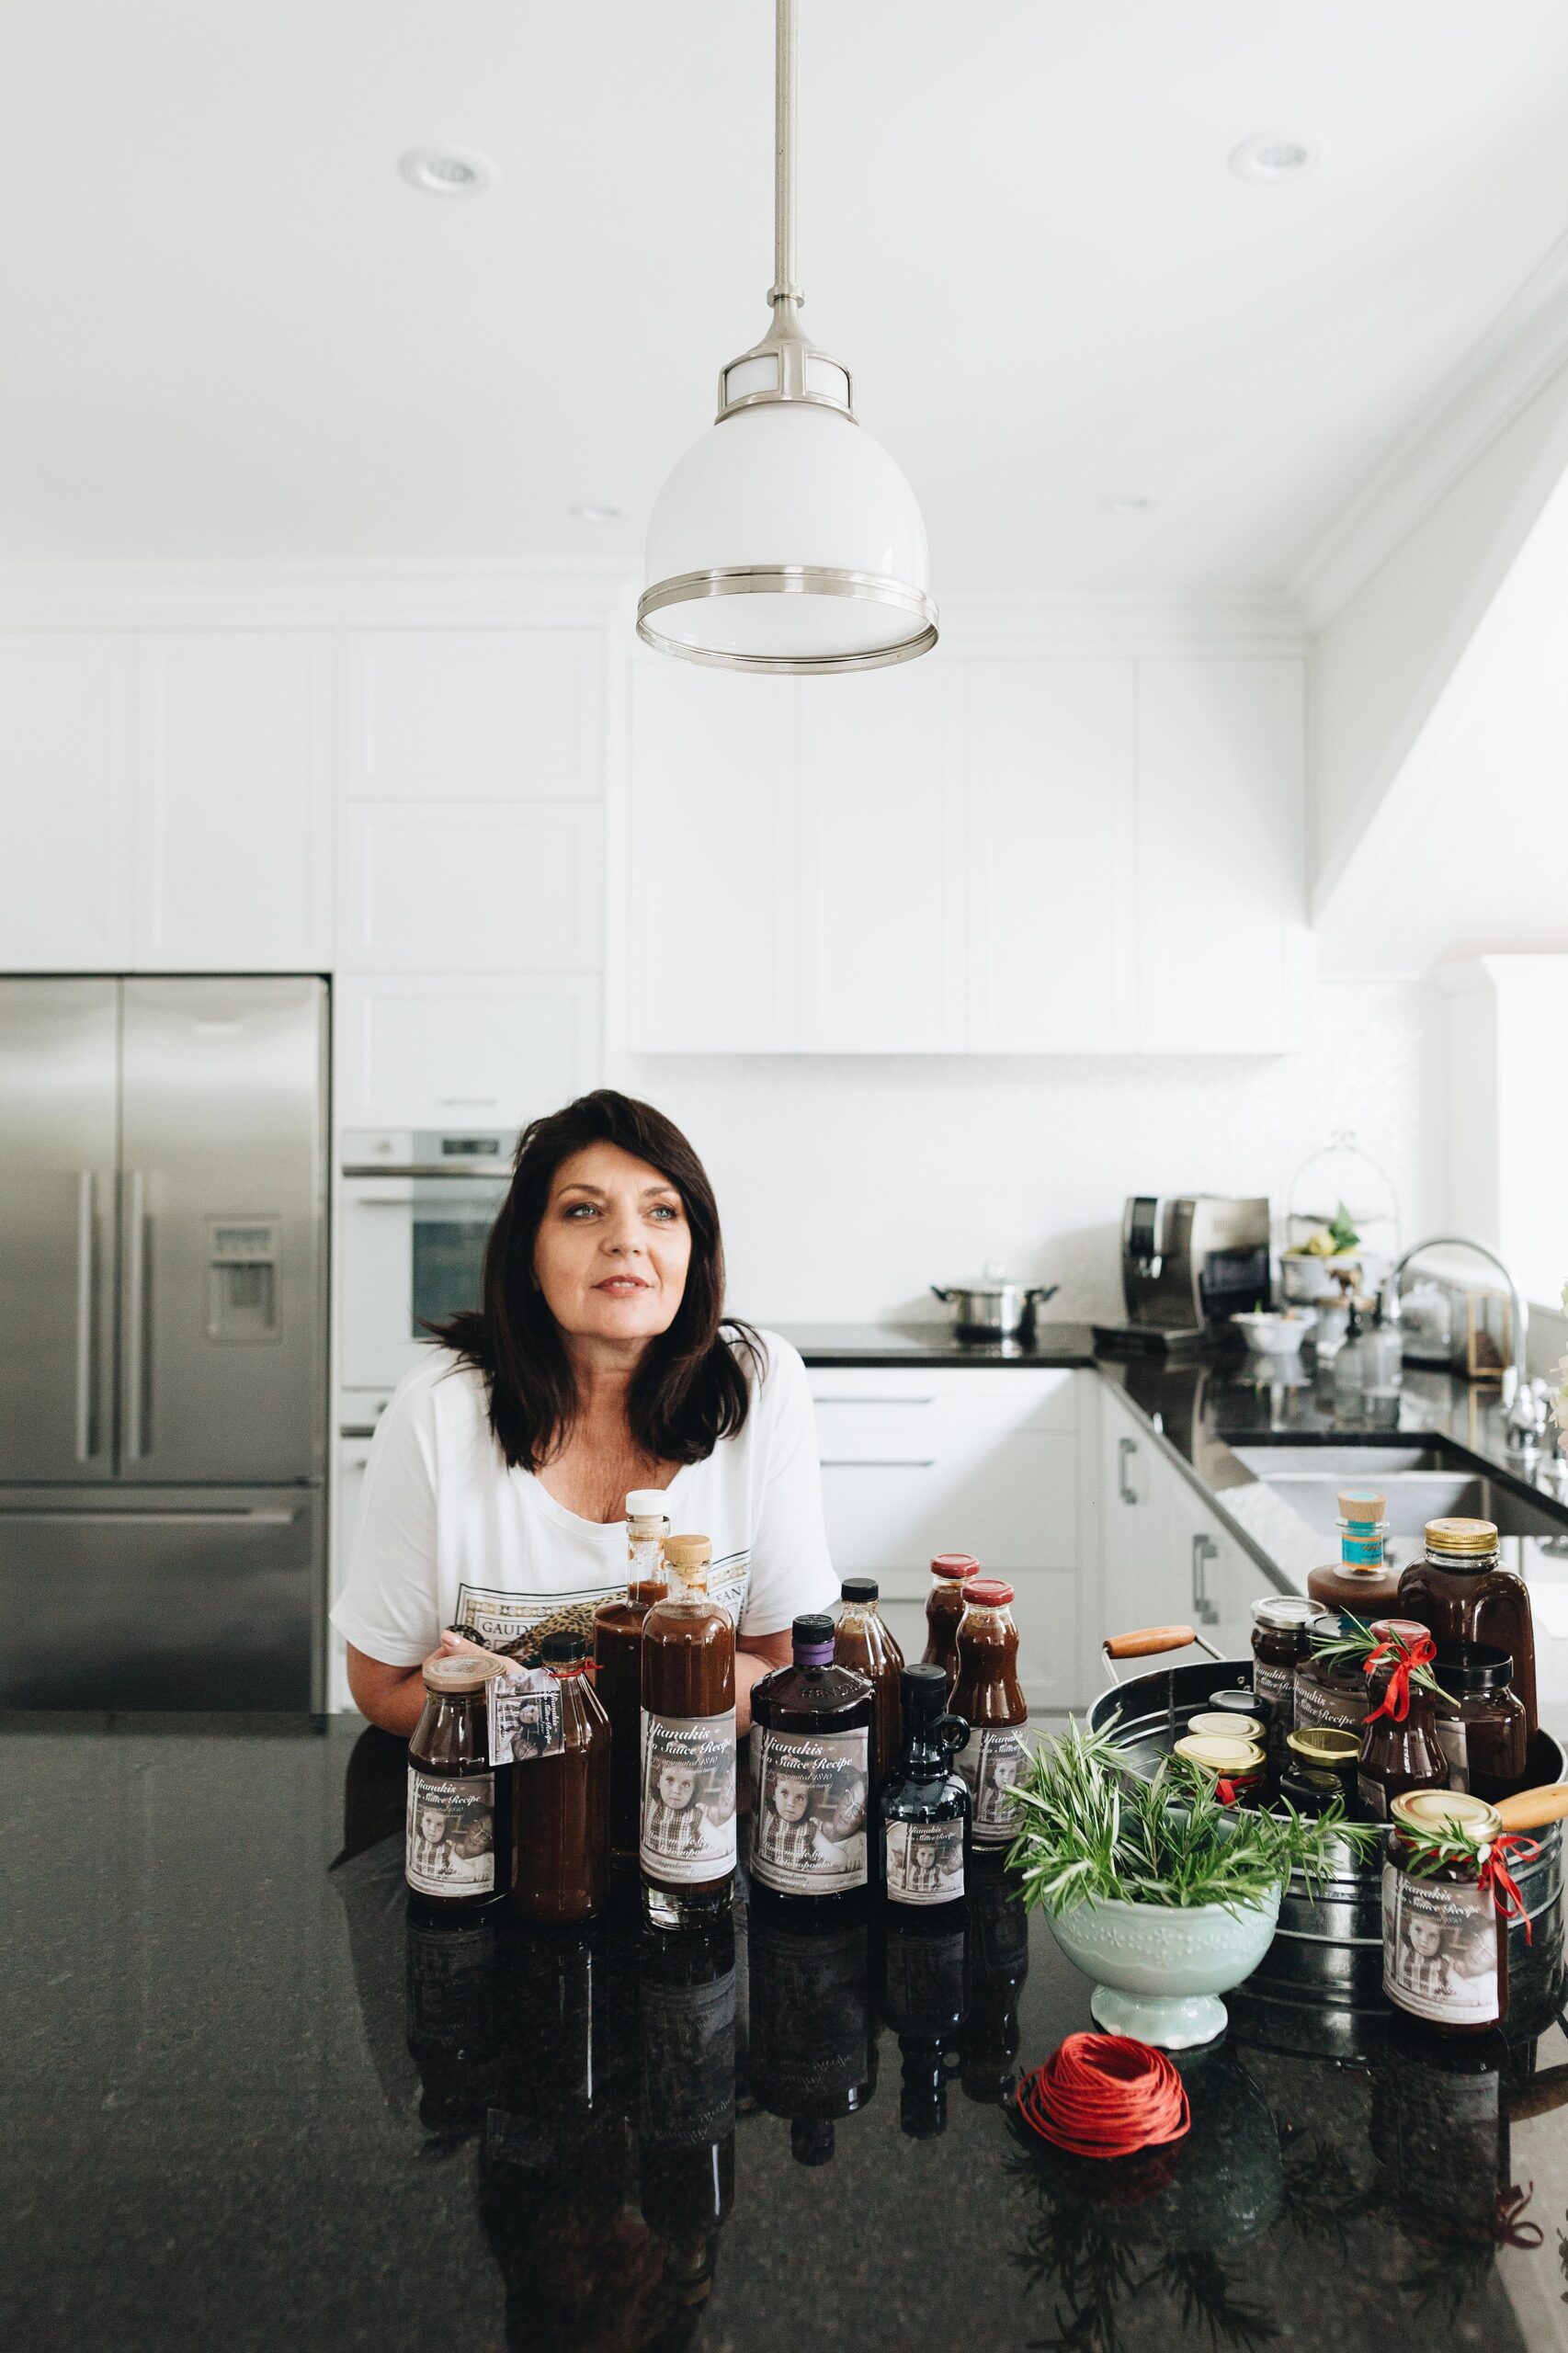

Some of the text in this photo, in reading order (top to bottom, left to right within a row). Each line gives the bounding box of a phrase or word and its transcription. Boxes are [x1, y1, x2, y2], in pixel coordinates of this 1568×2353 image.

[1318, 1708, 1356, 1727] Recipe
[648, 1720, 710, 1740] Yianakis
[983, 1730, 1024, 1745] Yianais
[661, 1740, 698, 1756] Sauce
[763, 1734, 824, 1756] Yianakis
[775, 1756, 810, 1770] Sauce
[812, 1757, 853, 1772] Recipe
[415, 1778, 457, 1793] Yianakis
[449, 1794, 481, 1807] Recipe
